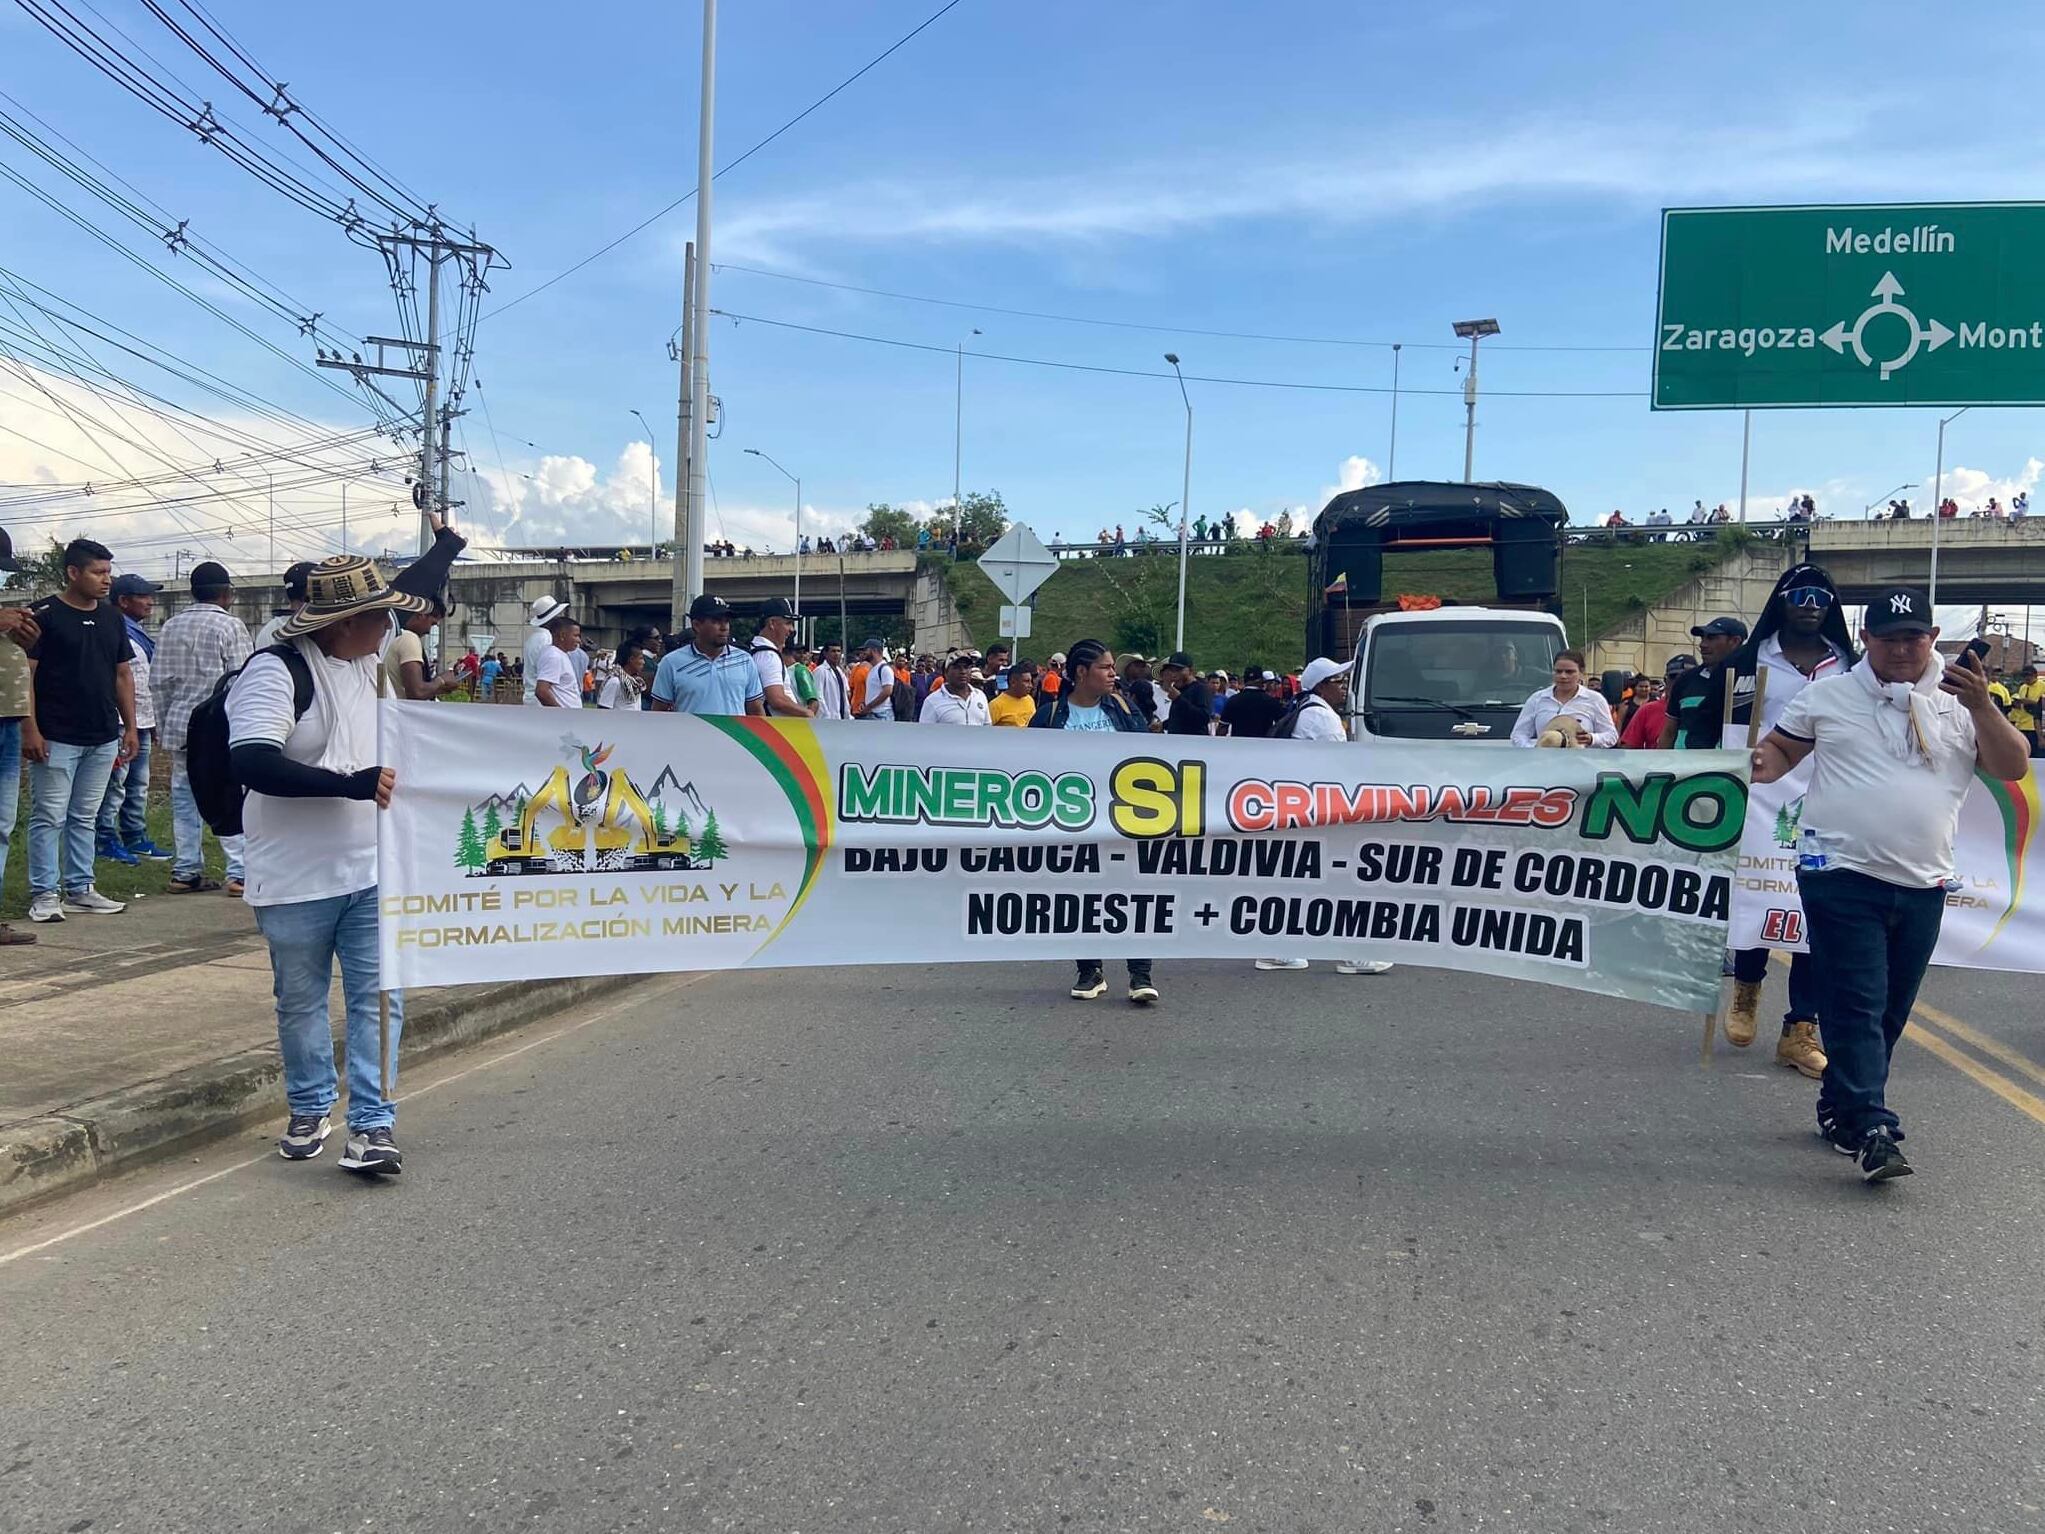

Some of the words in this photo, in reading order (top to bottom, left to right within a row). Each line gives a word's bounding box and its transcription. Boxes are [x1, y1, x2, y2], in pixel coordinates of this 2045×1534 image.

[1826, 225, 1955, 254] Medellín
[1662, 324, 1816, 357] Zaragoza
[1959, 321, 2043, 348] Mont
[1890, 594, 1912, 613] NY
[839, 762, 1096, 832] MINEROS
[1109, 757, 1207, 839] SI
[1225, 777, 1580, 832] CRIMINALES
[1579, 771, 1748, 853] NO
[844, 847, 948, 873] BAJO
[960, 843, 1101, 873] CAUCA
[1135, 839, 1321, 879] VALDIVIA
[1357, 841, 1441, 886] SUR
[1450, 847, 1506, 890] DE
[1513, 852, 1731, 921] CORDOBA
[382, 884, 501, 916] COMITÉ
[513, 888, 578, 910] POR
[590, 886, 629, 906] LA
[640, 884, 708, 904] VIDA
[719, 883, 739, 902] Y
[749, 882, 787, 901] LA
[396, 912, 651, 949] FORMALIZACIÓN
[662, 914, 772, 935] MINERA
[967, 892, 1175, 936] NORDESTE
[1230, 896, 1440, 943] COLOMBIA
[1450, 906, 1584, 963] UNIDA
[1761, 908, 1801, 943] EL
